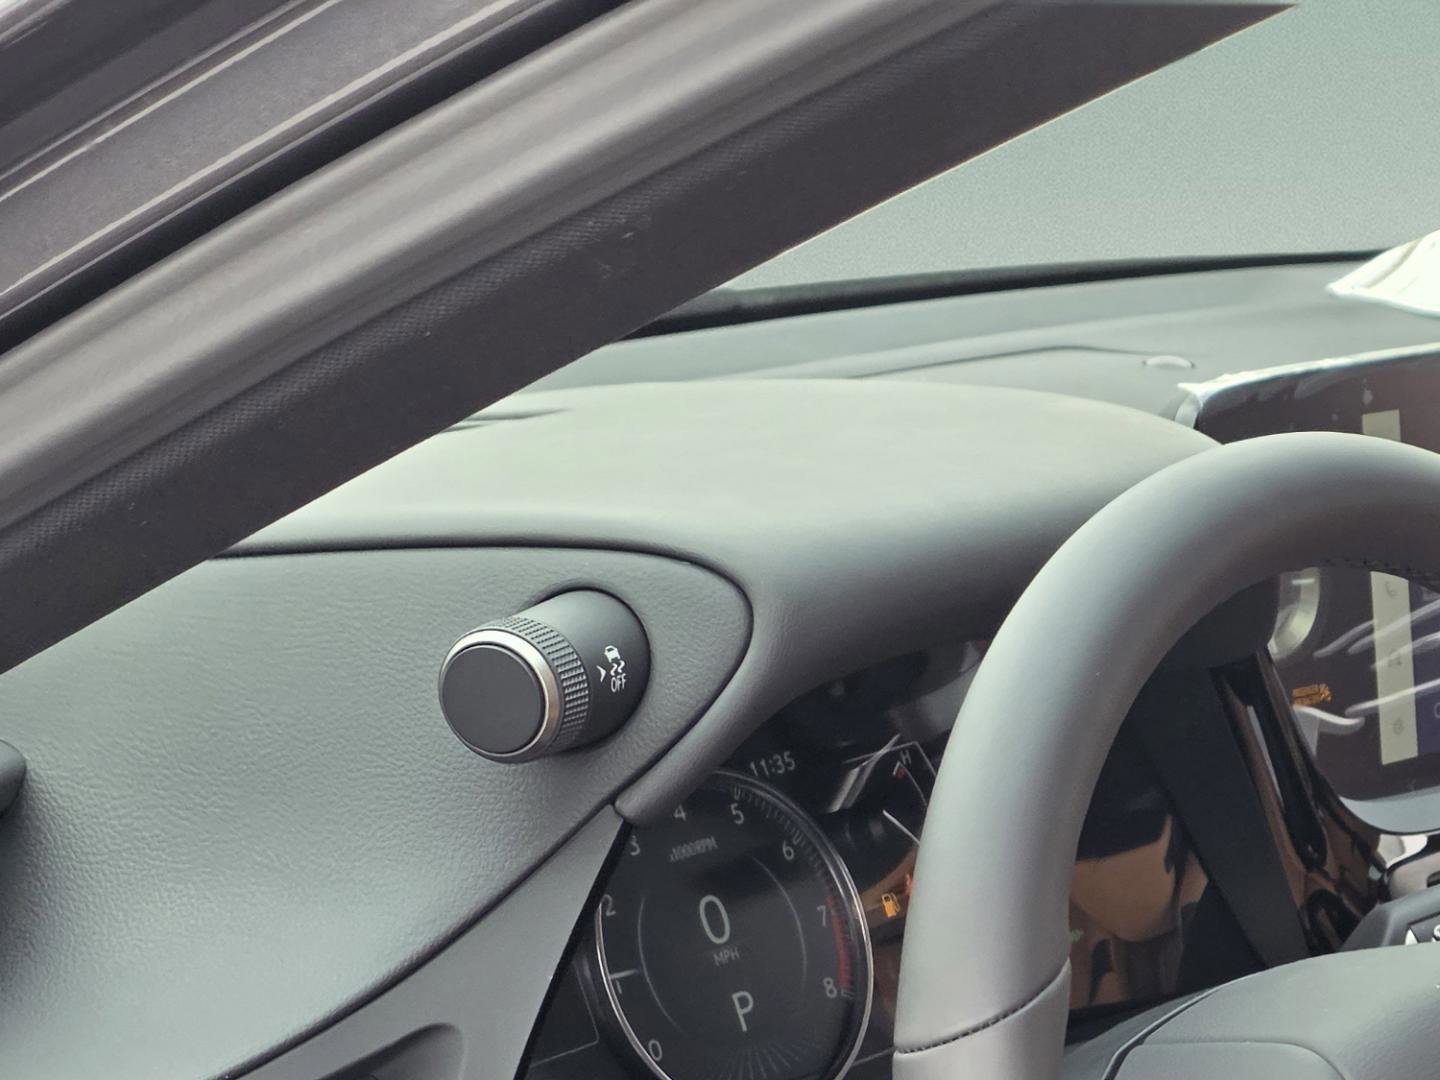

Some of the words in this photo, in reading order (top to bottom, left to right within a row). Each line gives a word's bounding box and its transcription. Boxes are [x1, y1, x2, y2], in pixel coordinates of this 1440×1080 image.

[610, 673, 627, 693] OFF
[749, 751, 796, 777] 11:35
[673, 804, 688, 821] 4
[730, 803, 744, 825] 5
[630, 835, 641, 856] 3
[782, 840, 795, 861] 6
[600, 894, 617, 916] 2
[816, 904, 827, 927] 7
[700, 894, 731, 945] 0
[713, 950, 740, 967] MPH
[822, 977, 838, 998] 8
[732, 990, 754, 1033] P
[649, 1039, 663, 1062] 0
